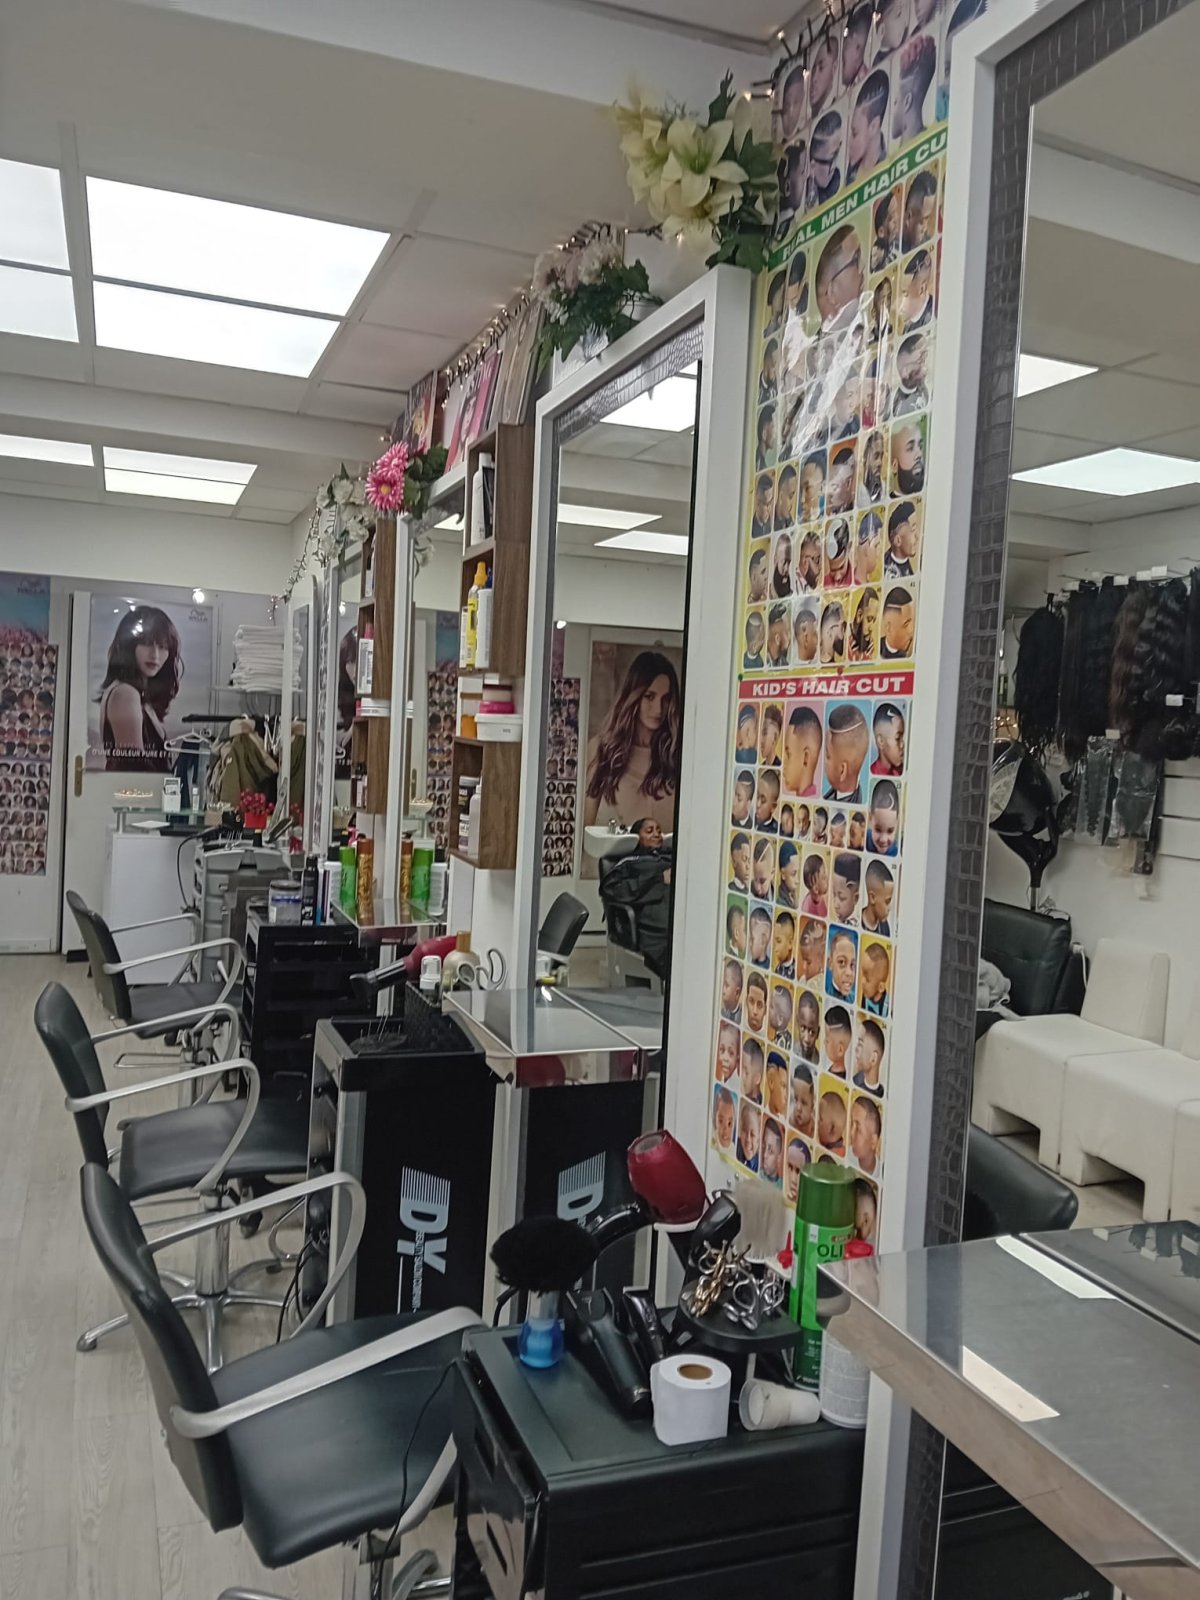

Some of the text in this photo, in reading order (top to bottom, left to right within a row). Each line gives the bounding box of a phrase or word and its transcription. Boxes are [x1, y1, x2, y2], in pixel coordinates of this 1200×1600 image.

[821, 193, 859, 229] MEN
[862, 159, 909, 201] HAIR
[914, 131, 947, 163] CU
[752, 677, 906, 697] KID'S HAIR CUT
[112, 748, 140, 757] COULEUR
[817, 1243, 844, 1258] OLI
